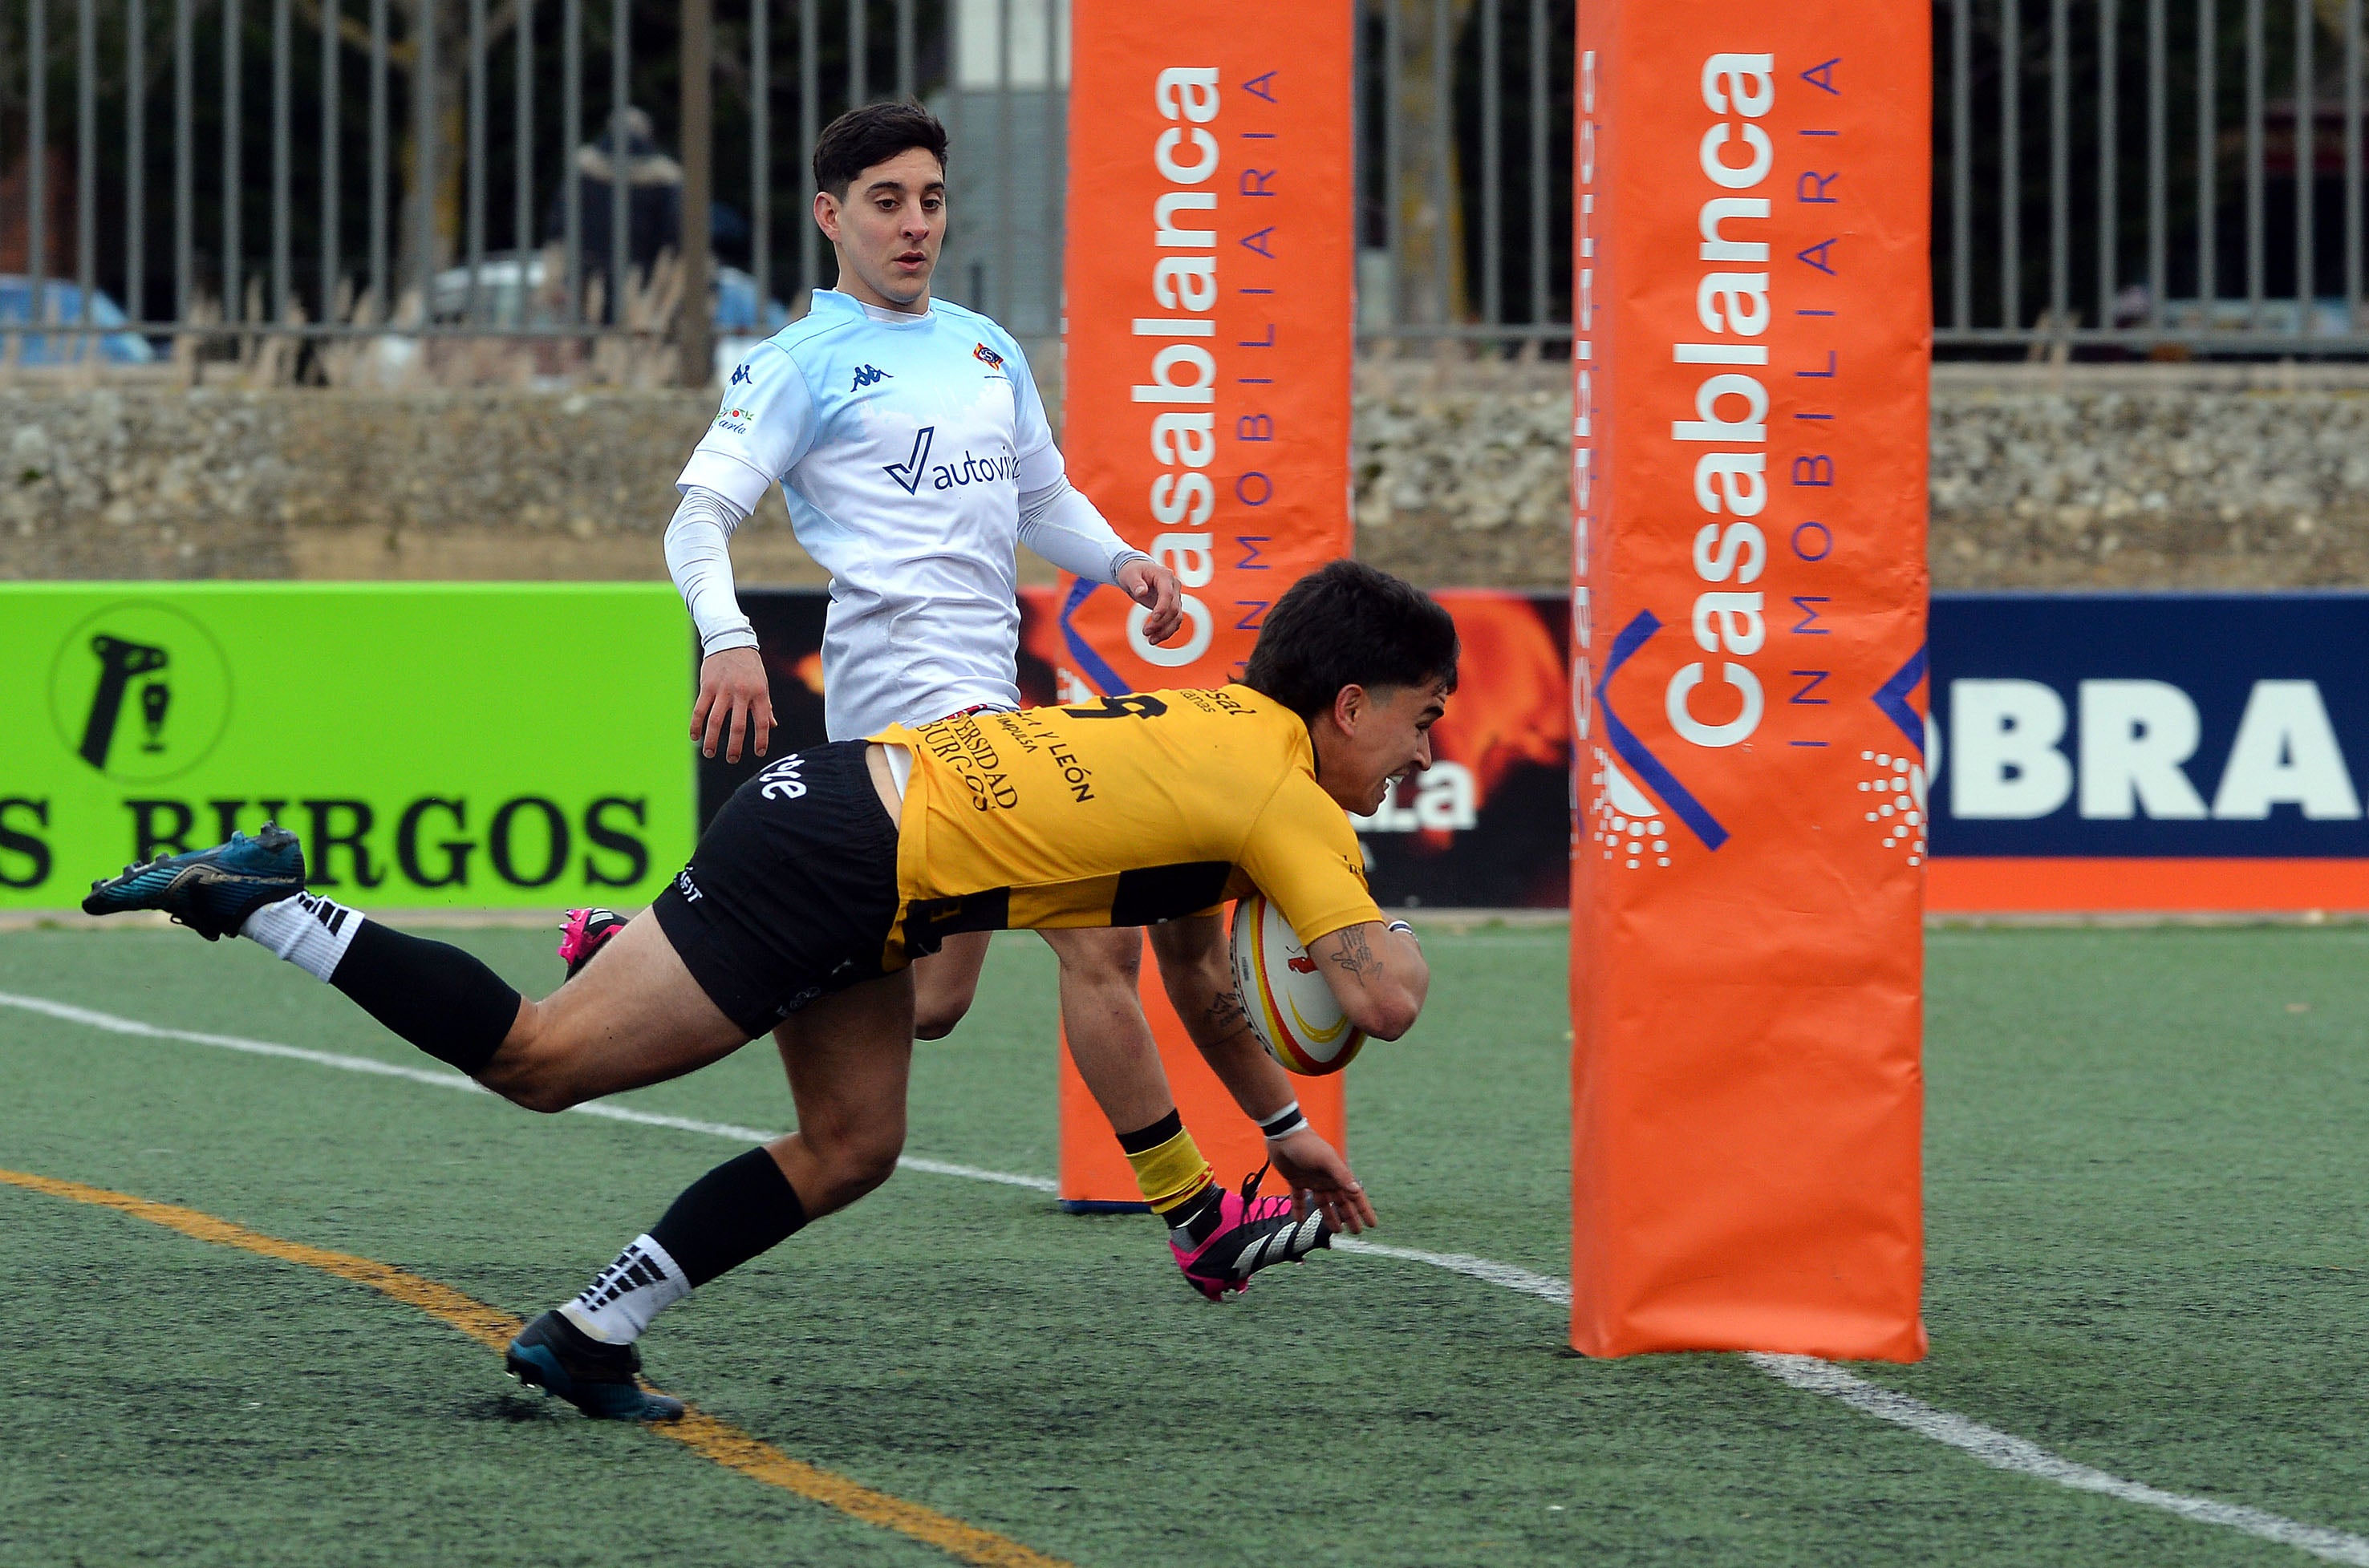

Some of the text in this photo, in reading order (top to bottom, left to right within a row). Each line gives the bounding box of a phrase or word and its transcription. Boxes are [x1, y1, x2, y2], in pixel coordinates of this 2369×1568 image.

[1126, 67, 1220, 667] Casablanca
[1665, 53, 1775, 748] Casablanca
[1788, 57, 1841, 747] INMOBILIARIA
[1048, 743, 1095, 803] LEÓN
[1925, 678, 2367, 821] BRA
